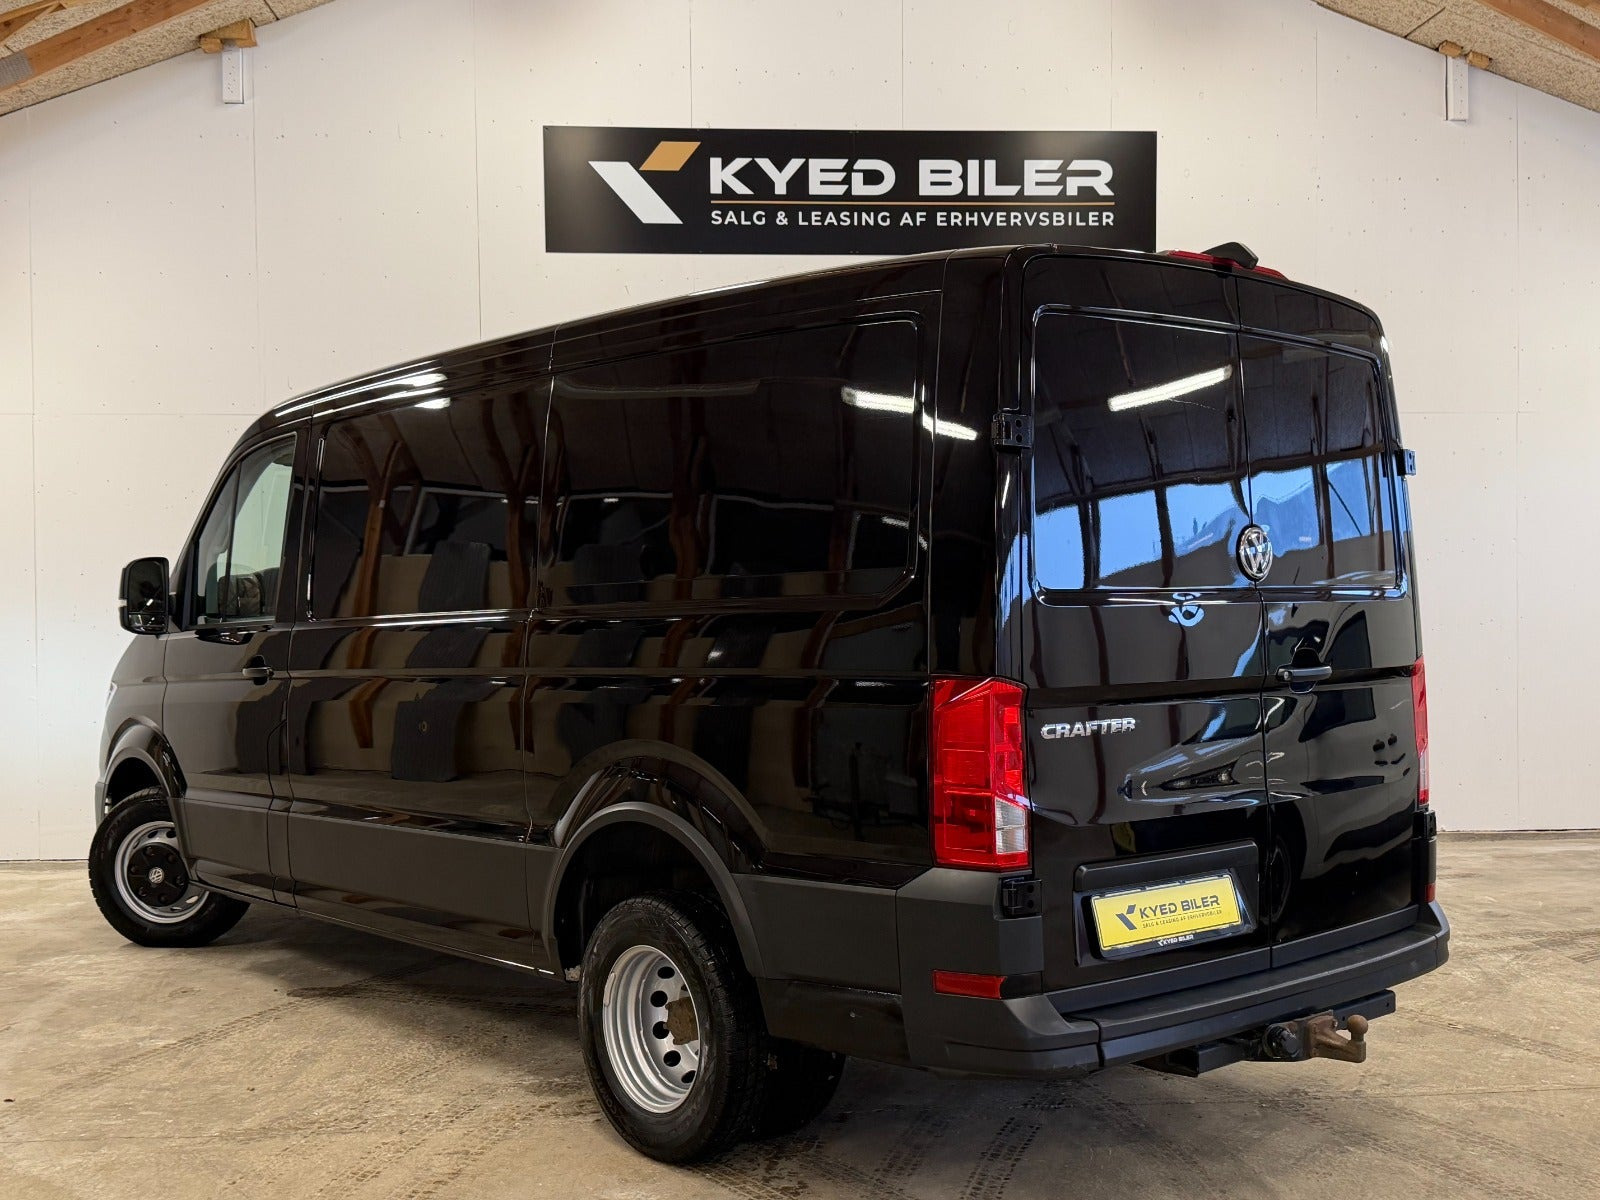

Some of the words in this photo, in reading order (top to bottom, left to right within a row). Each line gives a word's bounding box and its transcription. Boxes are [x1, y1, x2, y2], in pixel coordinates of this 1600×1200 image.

[709, 157, 896, 196] KYED
[918, 159, 1115, 196] BILER
[711, 210, 766, 226] SALG
[775, 211, 789, 226] &
[798, 211, 891, 226] LEASING
[900, 212, 927, 226] AF
[936, 211, 1115, 227] ERHVERVSBILER
[1040, 717, 1136, 740] CRAFTER
[1139, 902, 1177, 919] KYED
[1180, 895, 1220, 911] BILER
[1178, 934, 1194, 942] BILER
